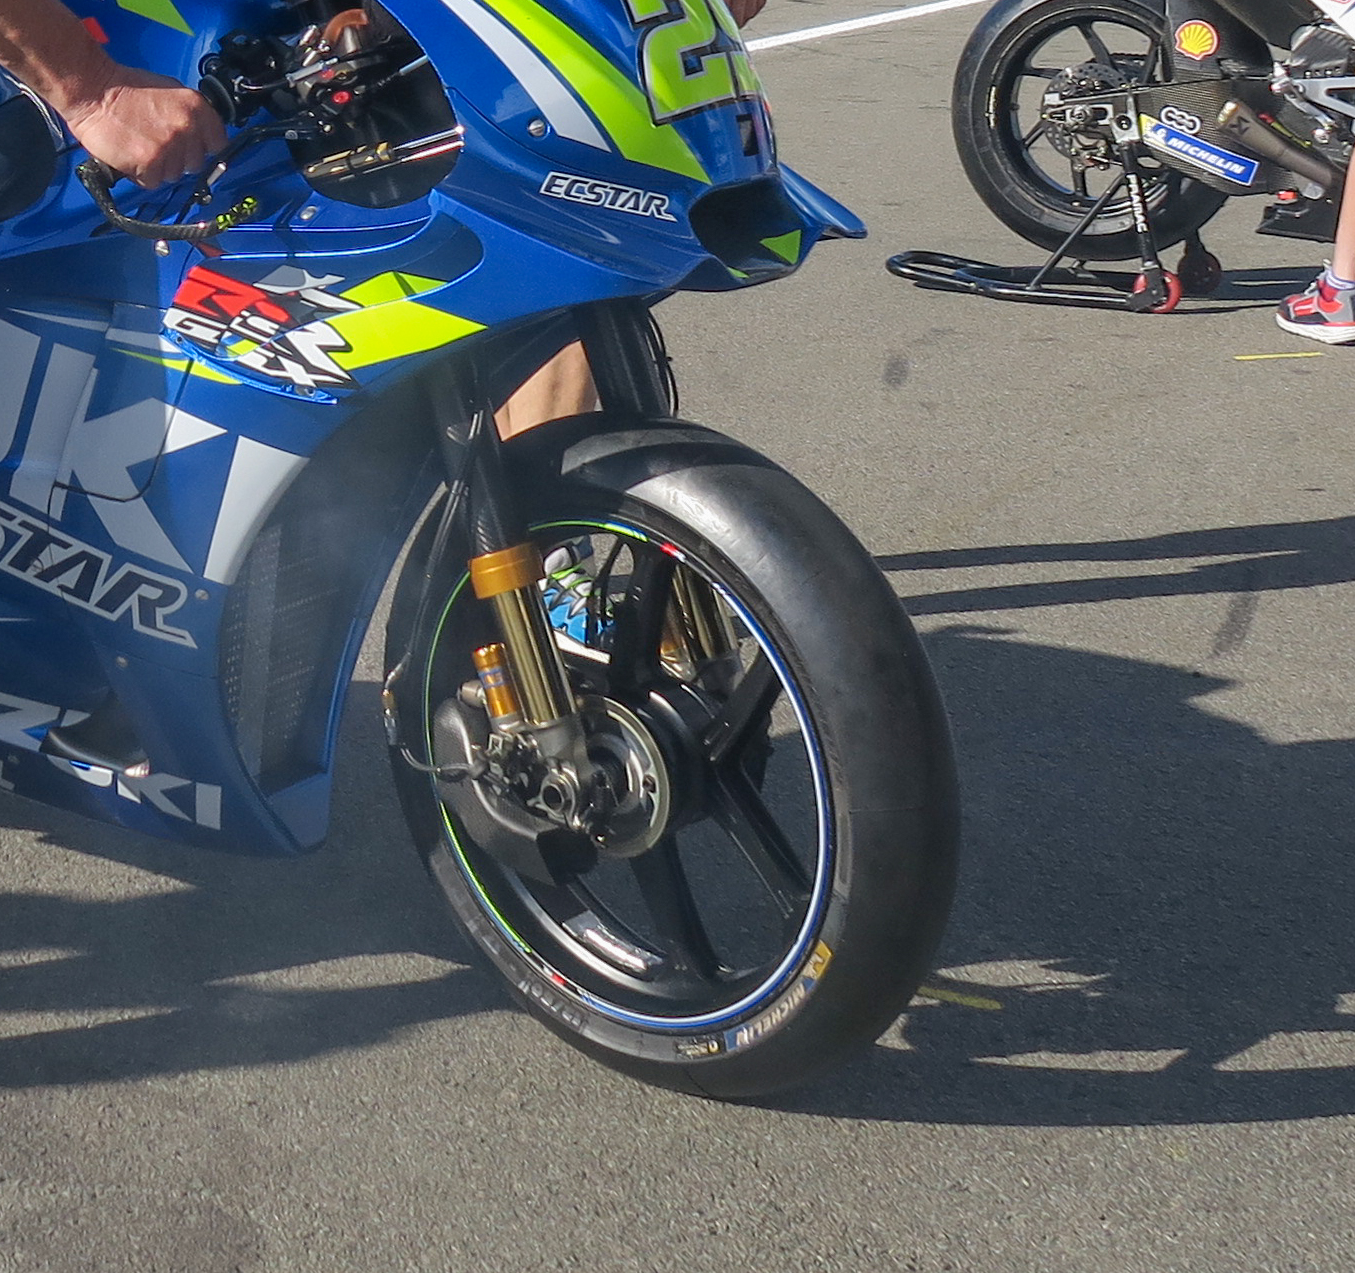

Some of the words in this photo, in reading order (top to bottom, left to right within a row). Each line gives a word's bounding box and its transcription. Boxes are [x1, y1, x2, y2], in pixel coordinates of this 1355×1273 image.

[1167, 136, 1246, 175] MICHELIN
[539, 171, 678, 222] ECSTAR
[1125, 174, 1148, 233] PRAMAC
[736, 983, 806, 1046] MICHELIN
